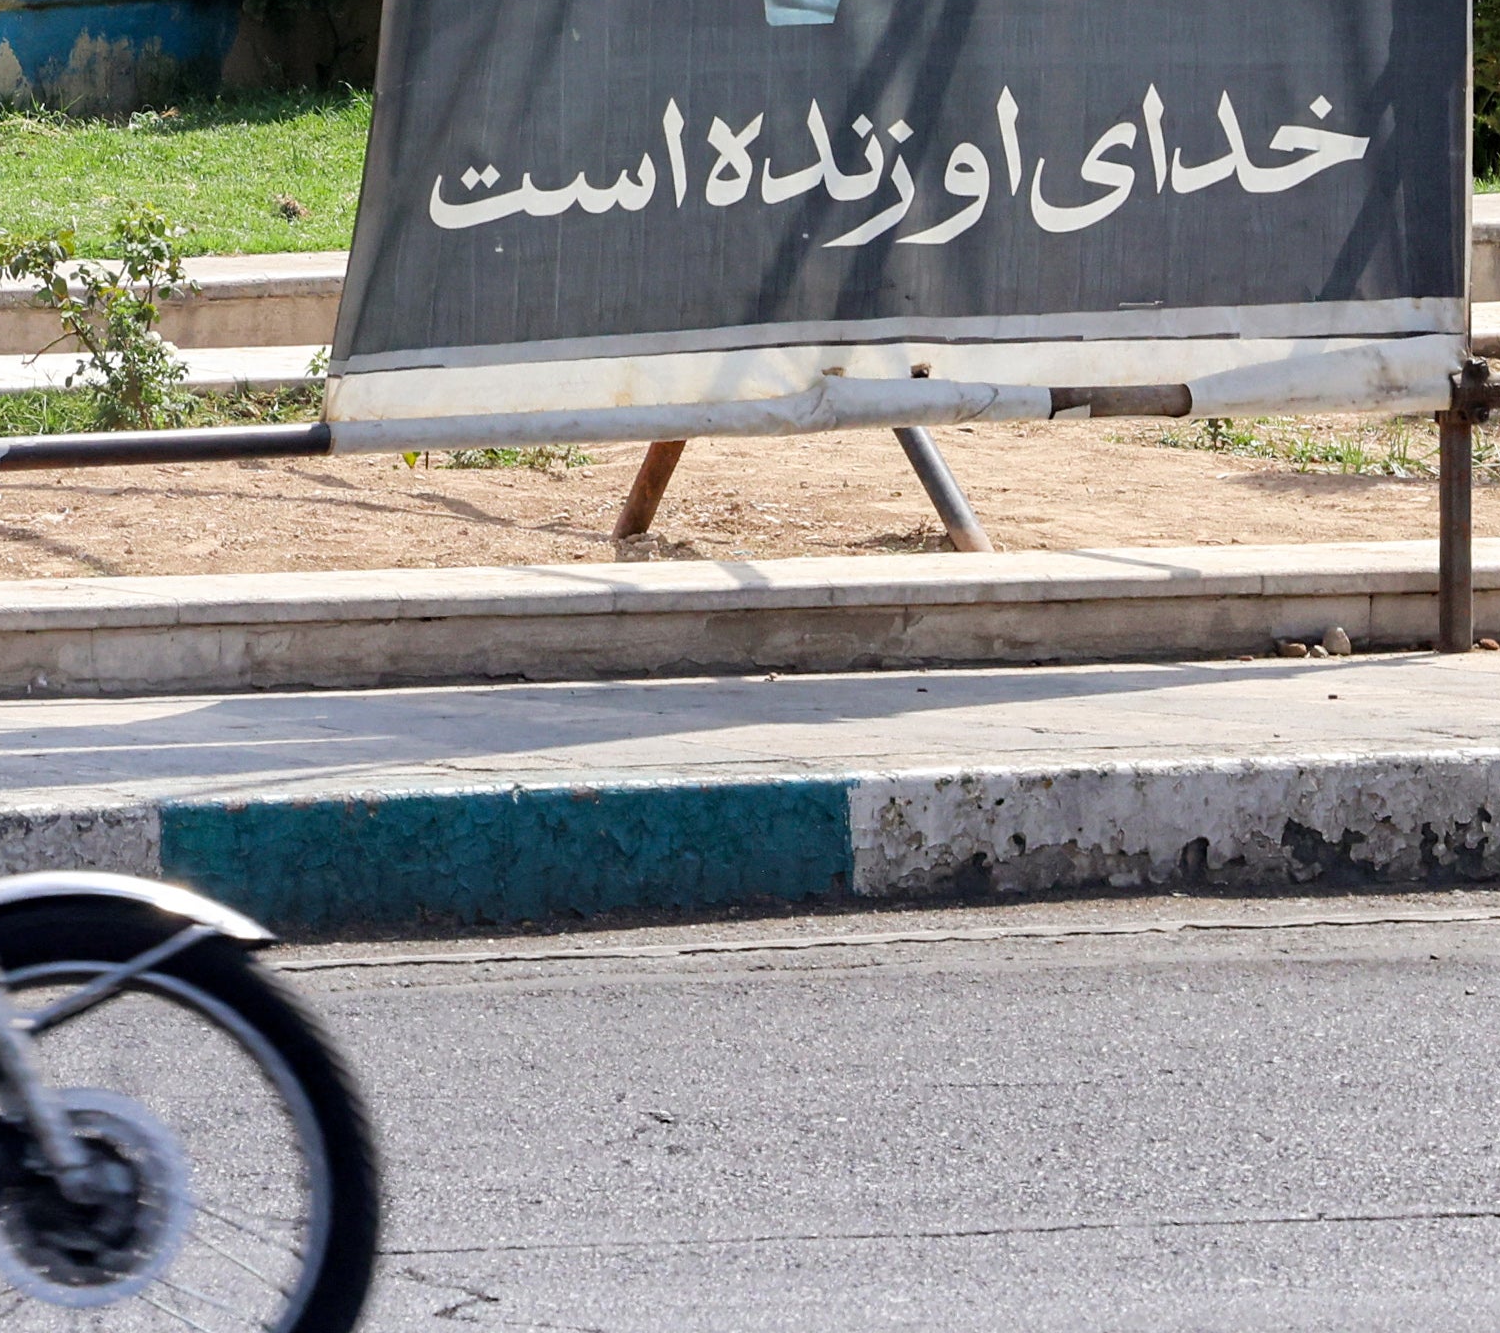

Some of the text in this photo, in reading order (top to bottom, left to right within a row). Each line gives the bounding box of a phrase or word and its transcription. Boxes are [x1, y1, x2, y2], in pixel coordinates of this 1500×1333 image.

[428, 82, 1371, 249] خدای او زنده است
